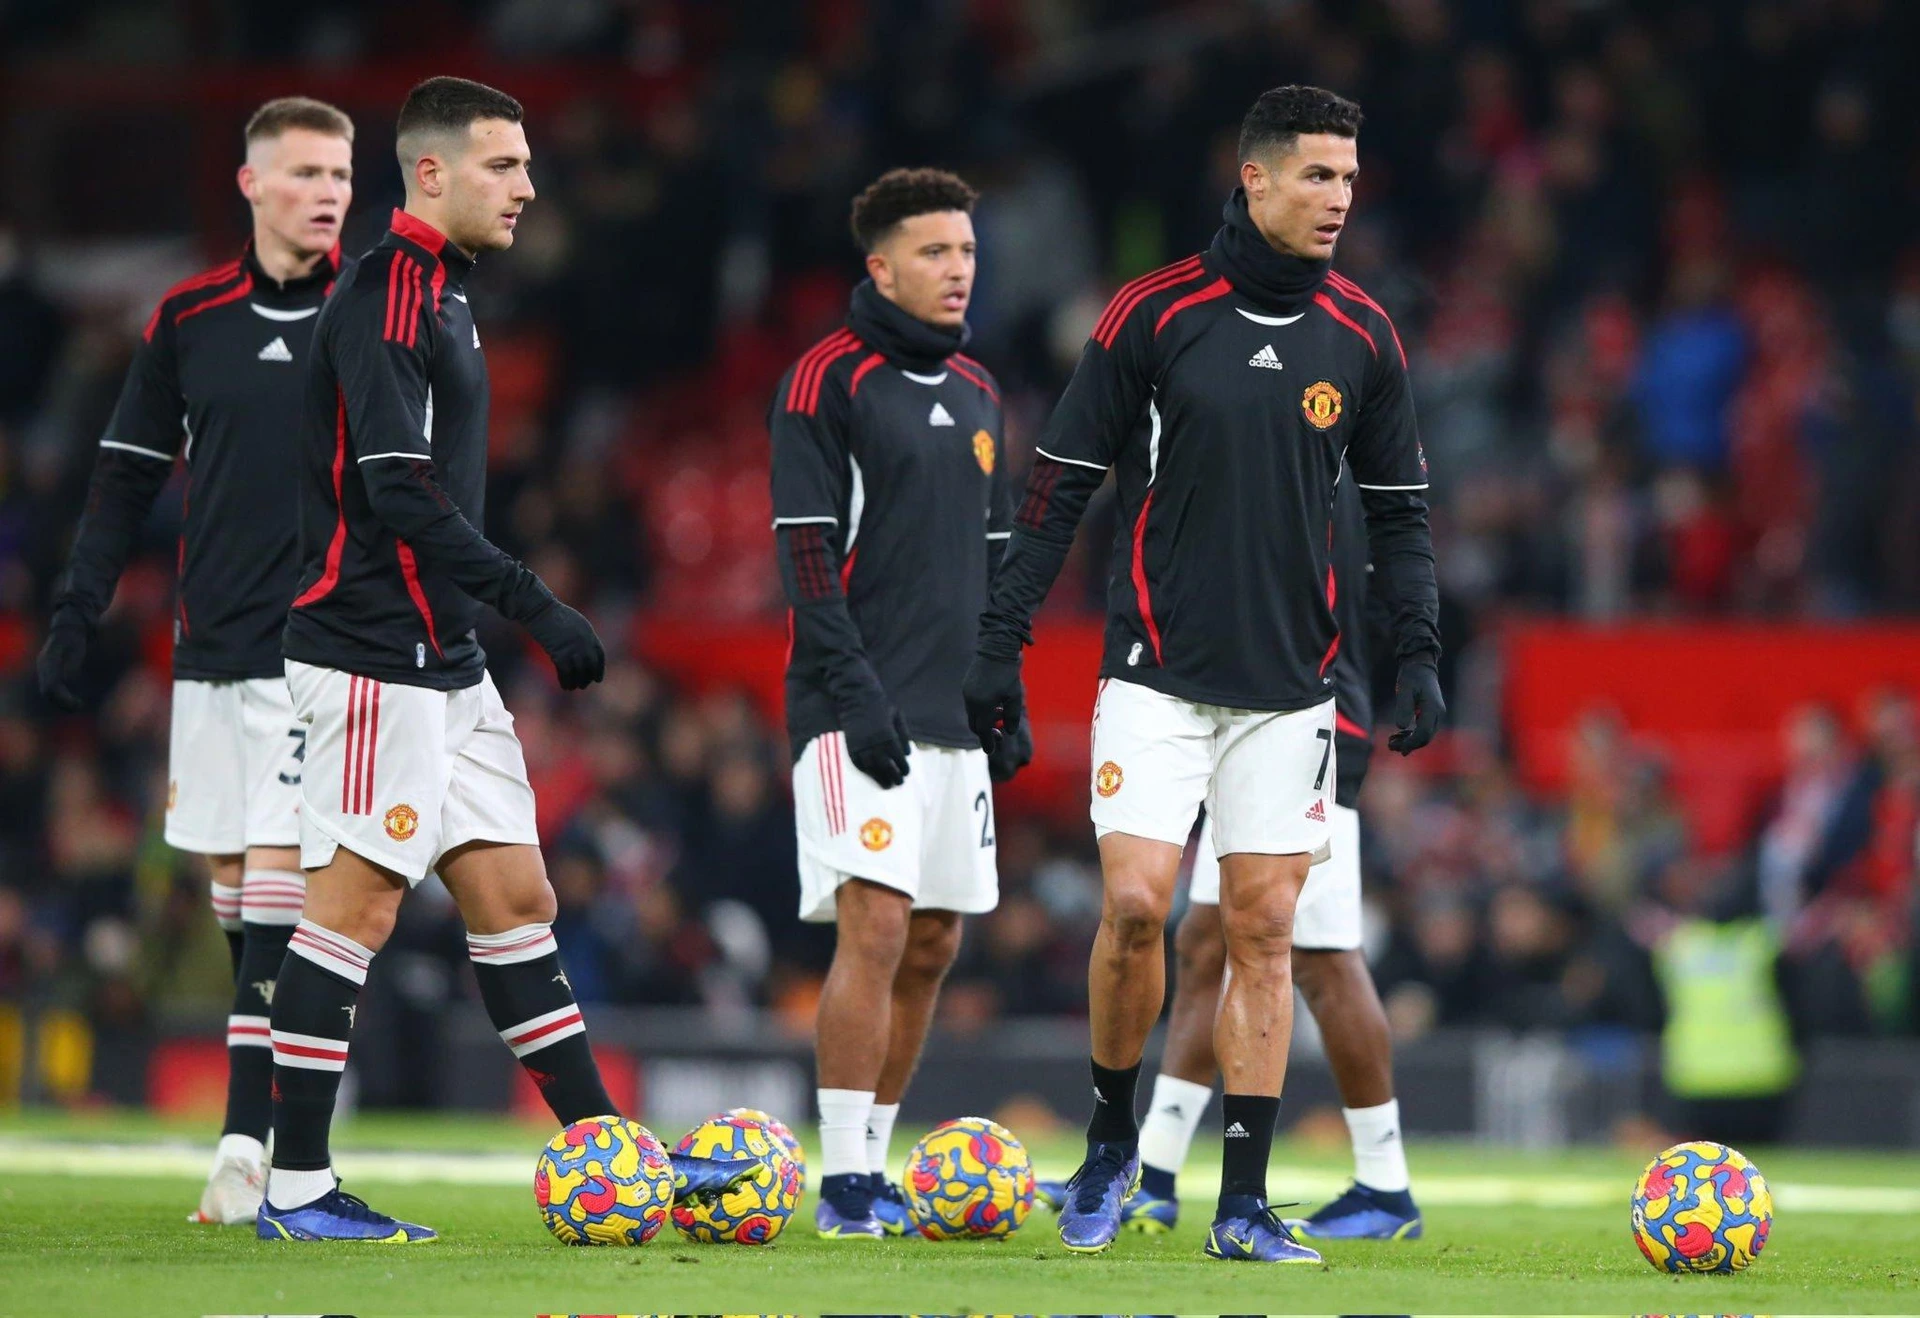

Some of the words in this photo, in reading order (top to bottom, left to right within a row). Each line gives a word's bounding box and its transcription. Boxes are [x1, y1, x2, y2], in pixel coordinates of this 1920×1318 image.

[1248, 358, 1283, 370] adidas
[1310, 413, 1333, 425] UNITED
[1313, 728, 1332, 791] 7
[975, 790, 995, 848] 2
[1305, 811, 1327, 823] adidas
[1224, 1130, 1251, 1139] adidas
